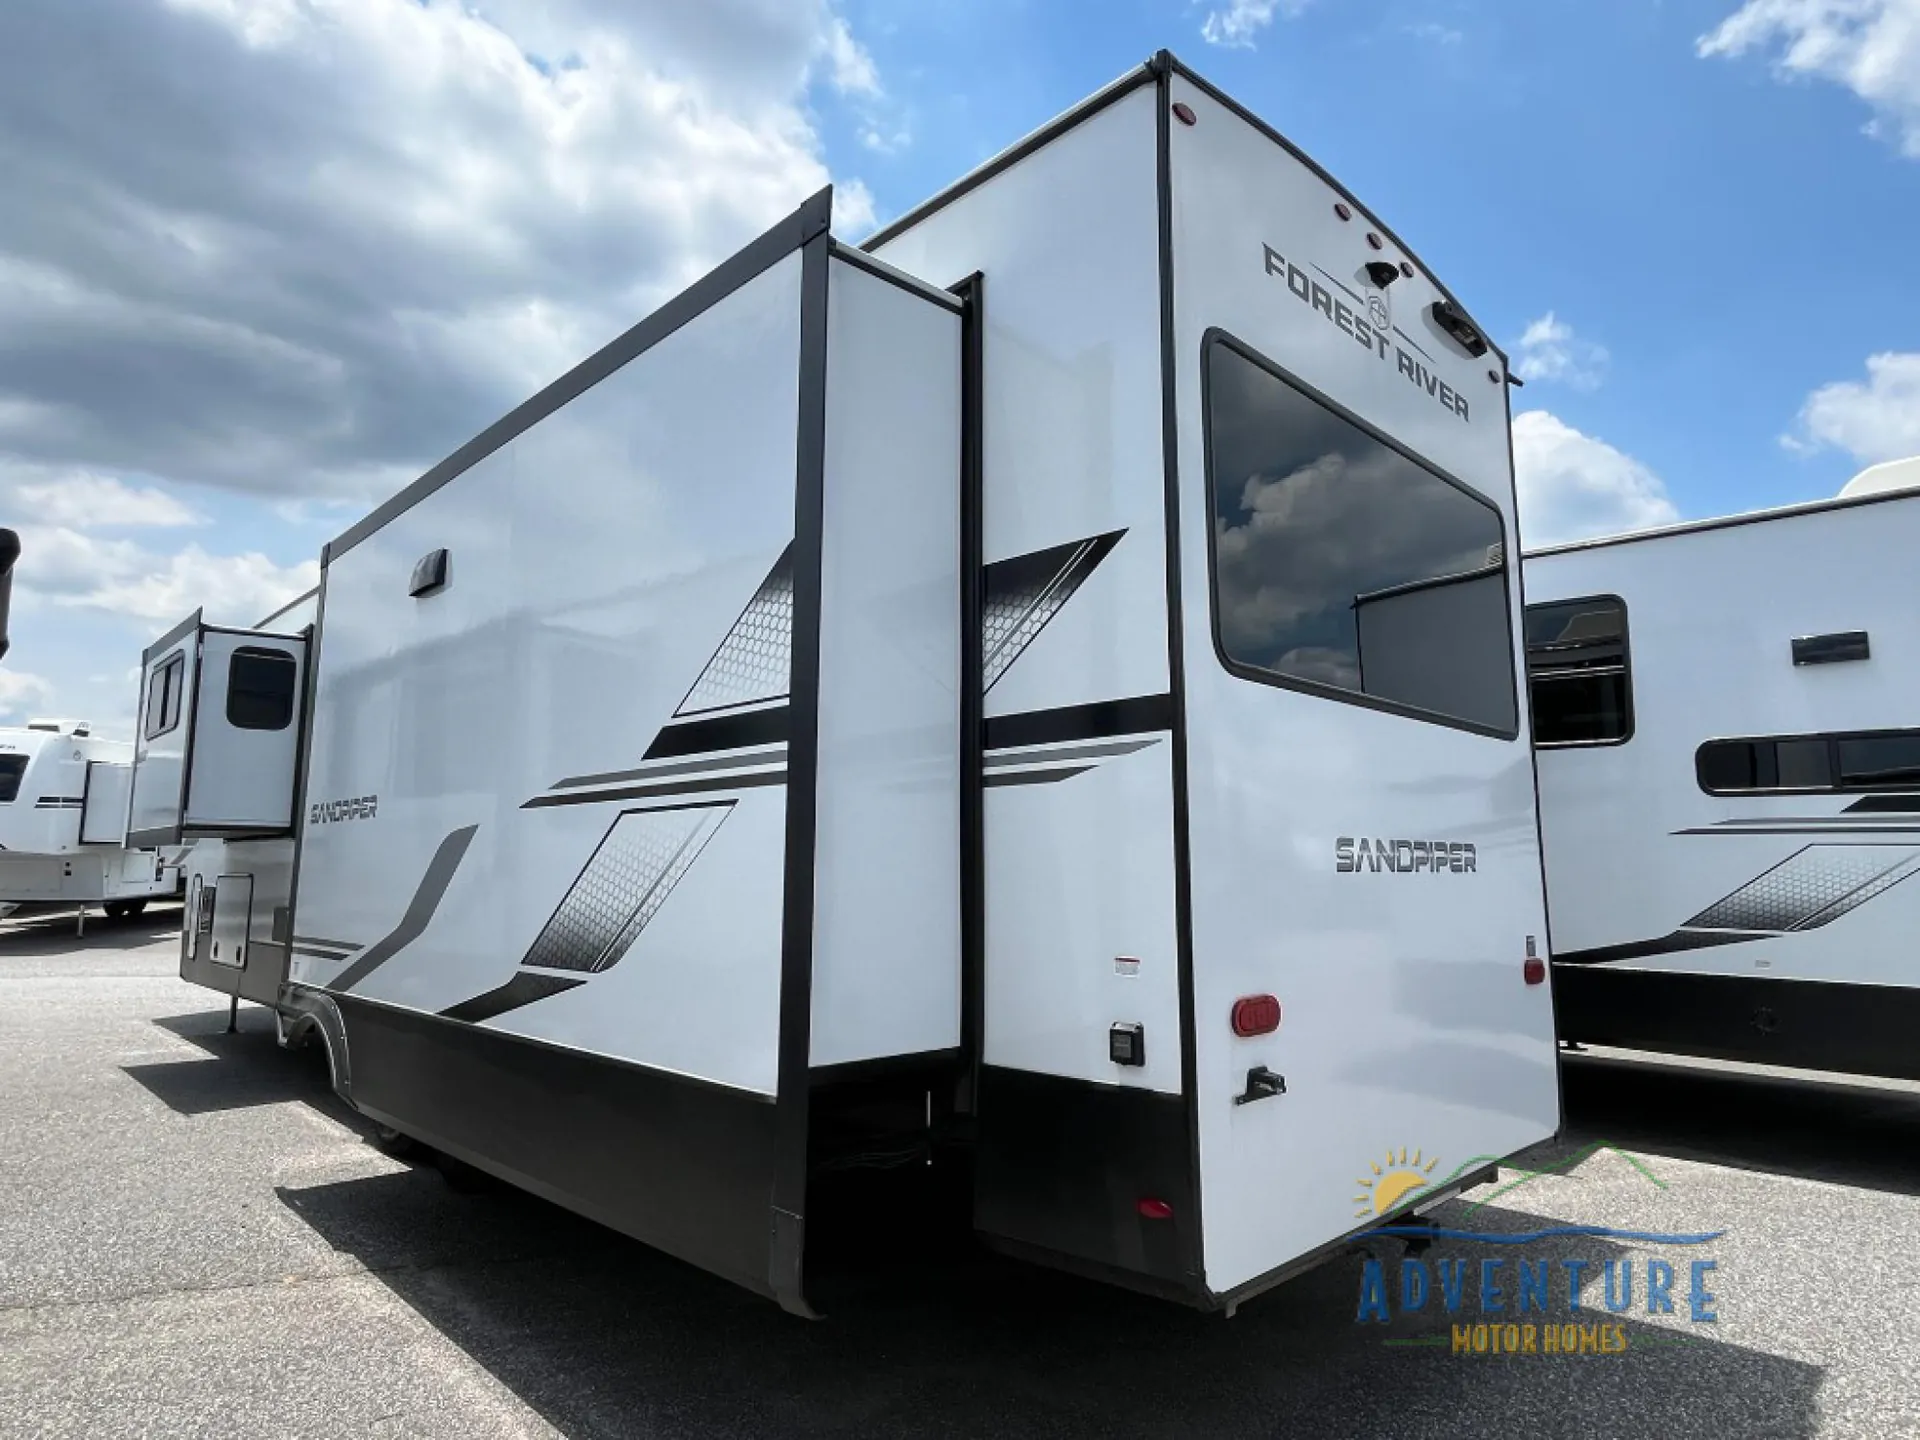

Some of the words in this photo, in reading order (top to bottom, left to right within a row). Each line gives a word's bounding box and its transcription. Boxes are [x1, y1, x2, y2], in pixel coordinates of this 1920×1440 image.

[1262, 242, 1390, 361] FOREST
[1396, 347, 1470, 423] RIVER
[310, 794, 377, 825] SANDPIPER
[1336, 837, 1477, 873] SANDPIPER
